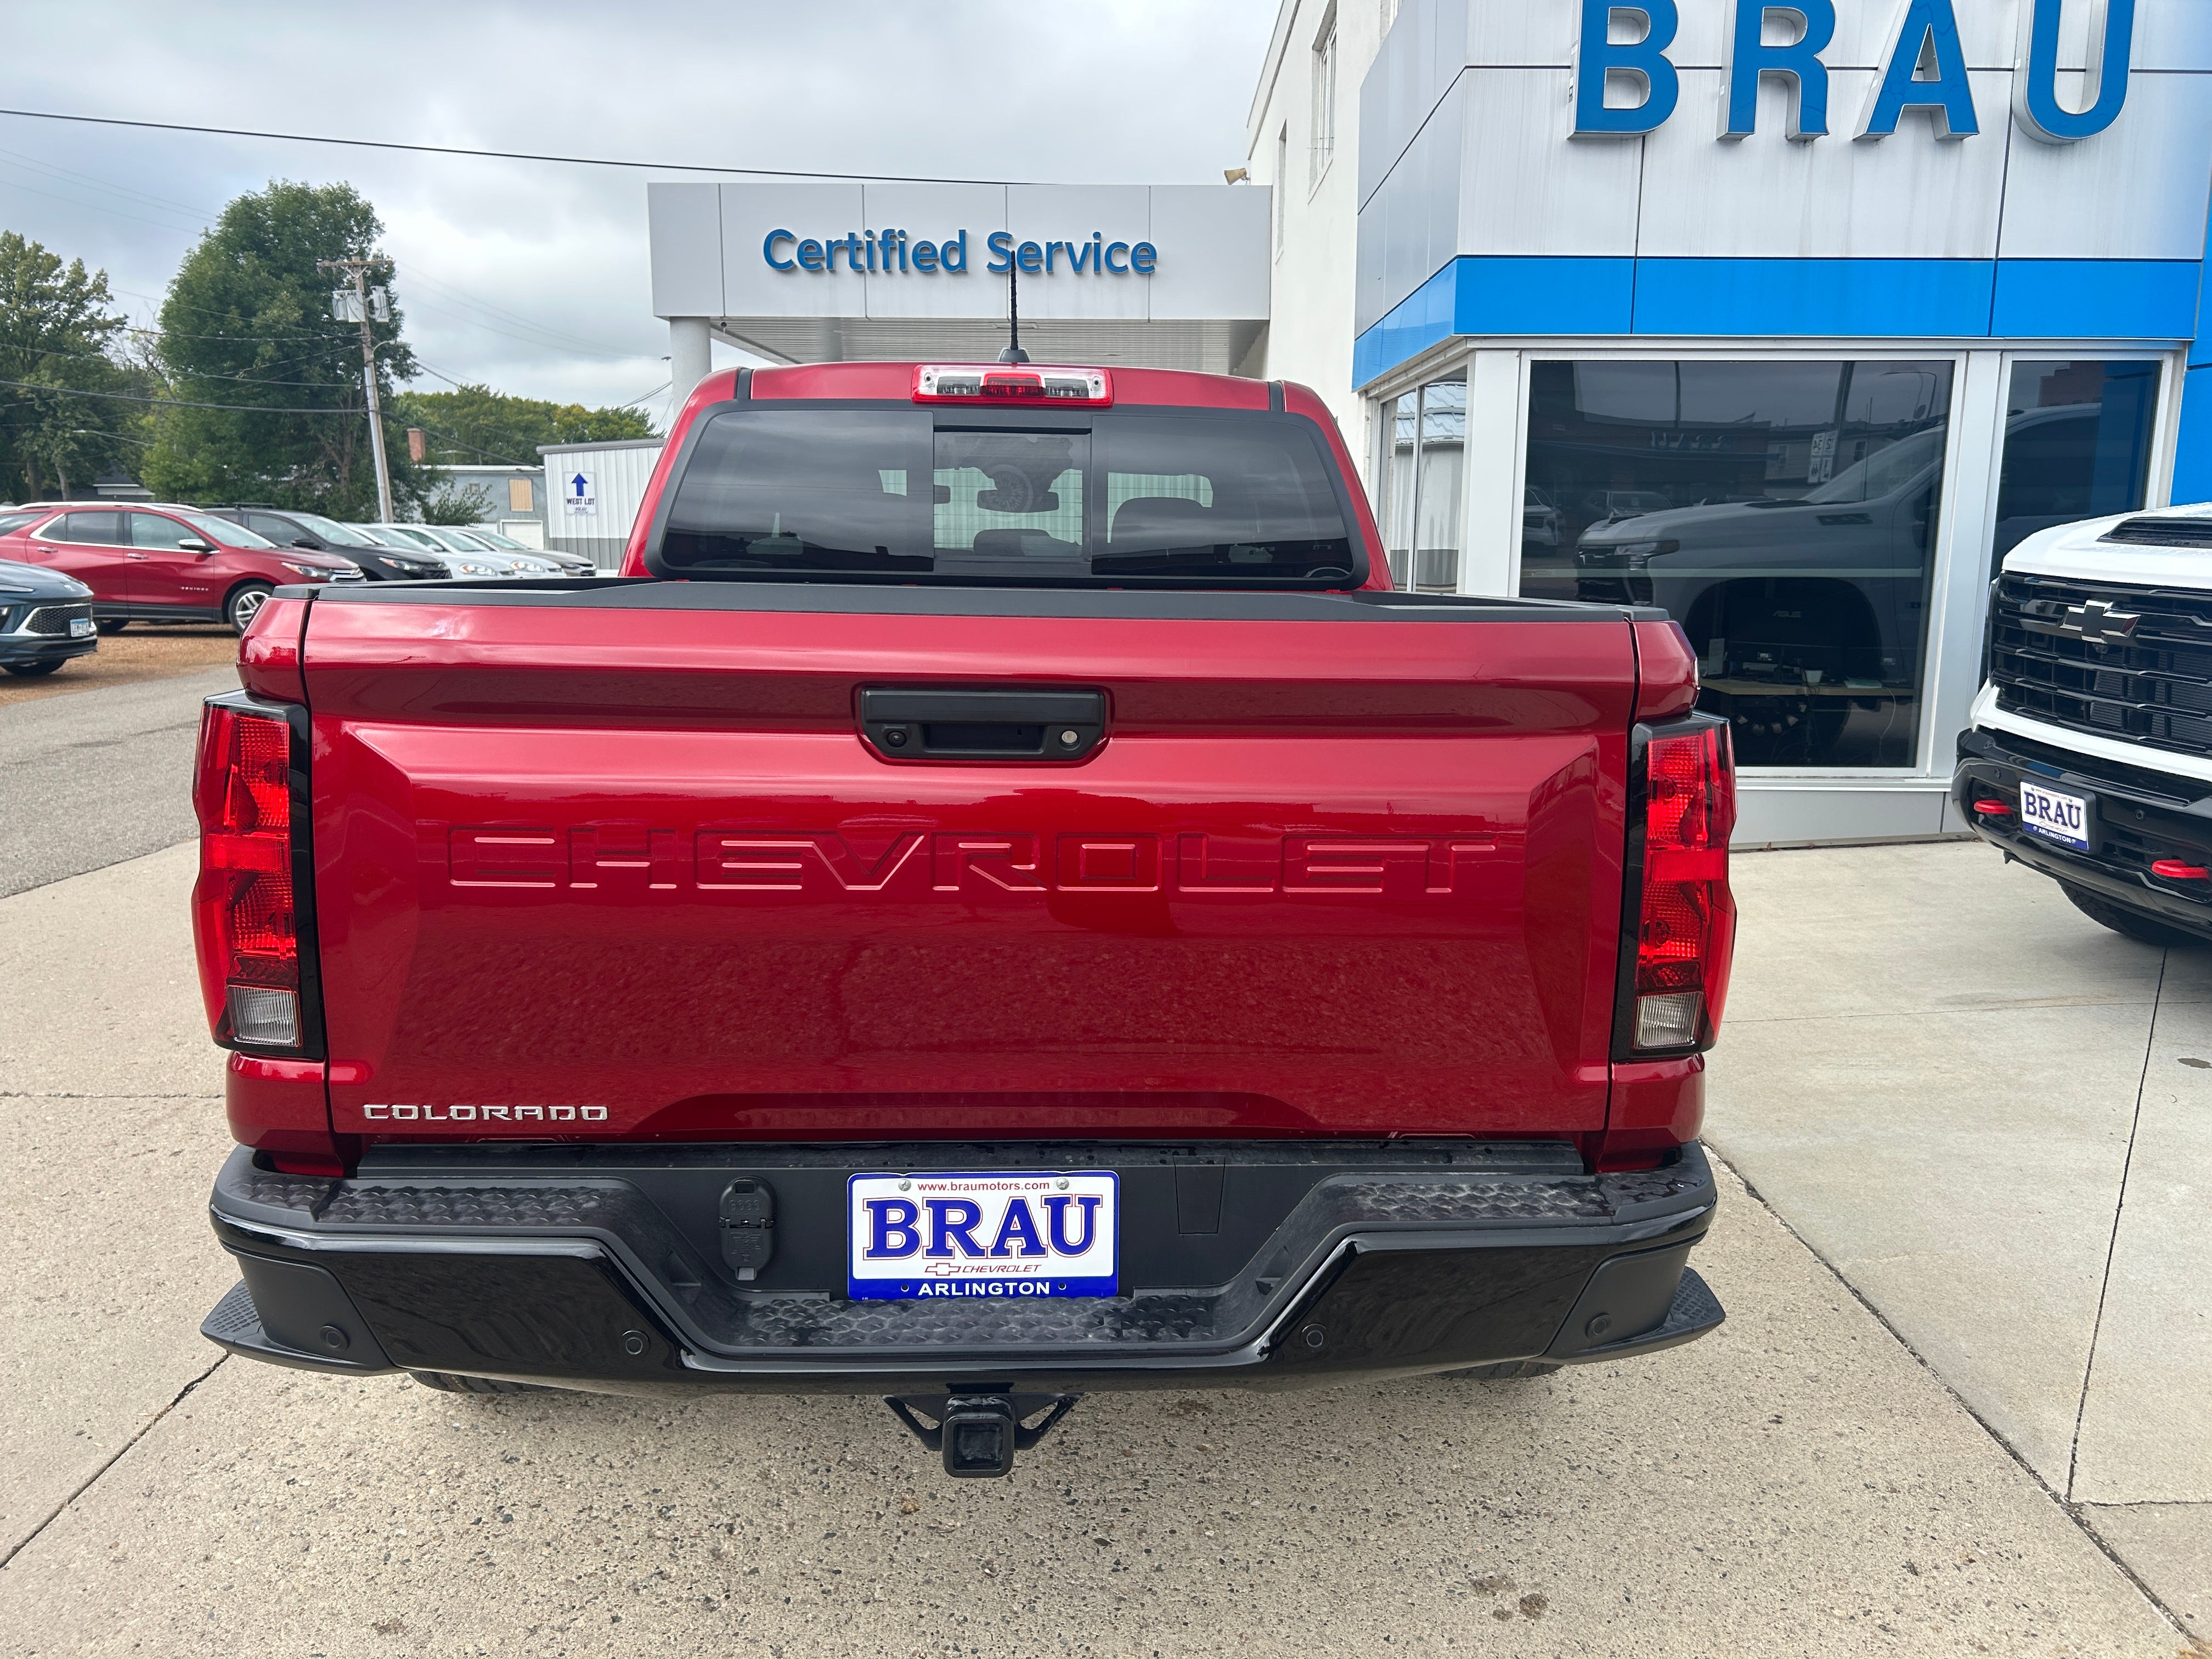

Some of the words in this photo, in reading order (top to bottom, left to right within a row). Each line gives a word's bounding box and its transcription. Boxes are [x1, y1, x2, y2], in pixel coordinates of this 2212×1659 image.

[1569, 0, 2135, 142] BRAU
[763, 229, 967, 272] Certified
[987, 232, 1158, 274] Service
[2024, 790, 2081, 831] BRAU
[2038, 828, 2071, 843] ARLINGTON
[447, 825, 1497, 894] CHEVROLET
[363, 1104, 608, 1121] COLORADO
[917, 1181, 1050, 1192] www.braumotors.com
[862, 1194, 1103, 1261] BRAU
[962, 1264, 1042, 1273] CHEVROLET
[918, 1282, 1050, 1296] ARLINGTON
